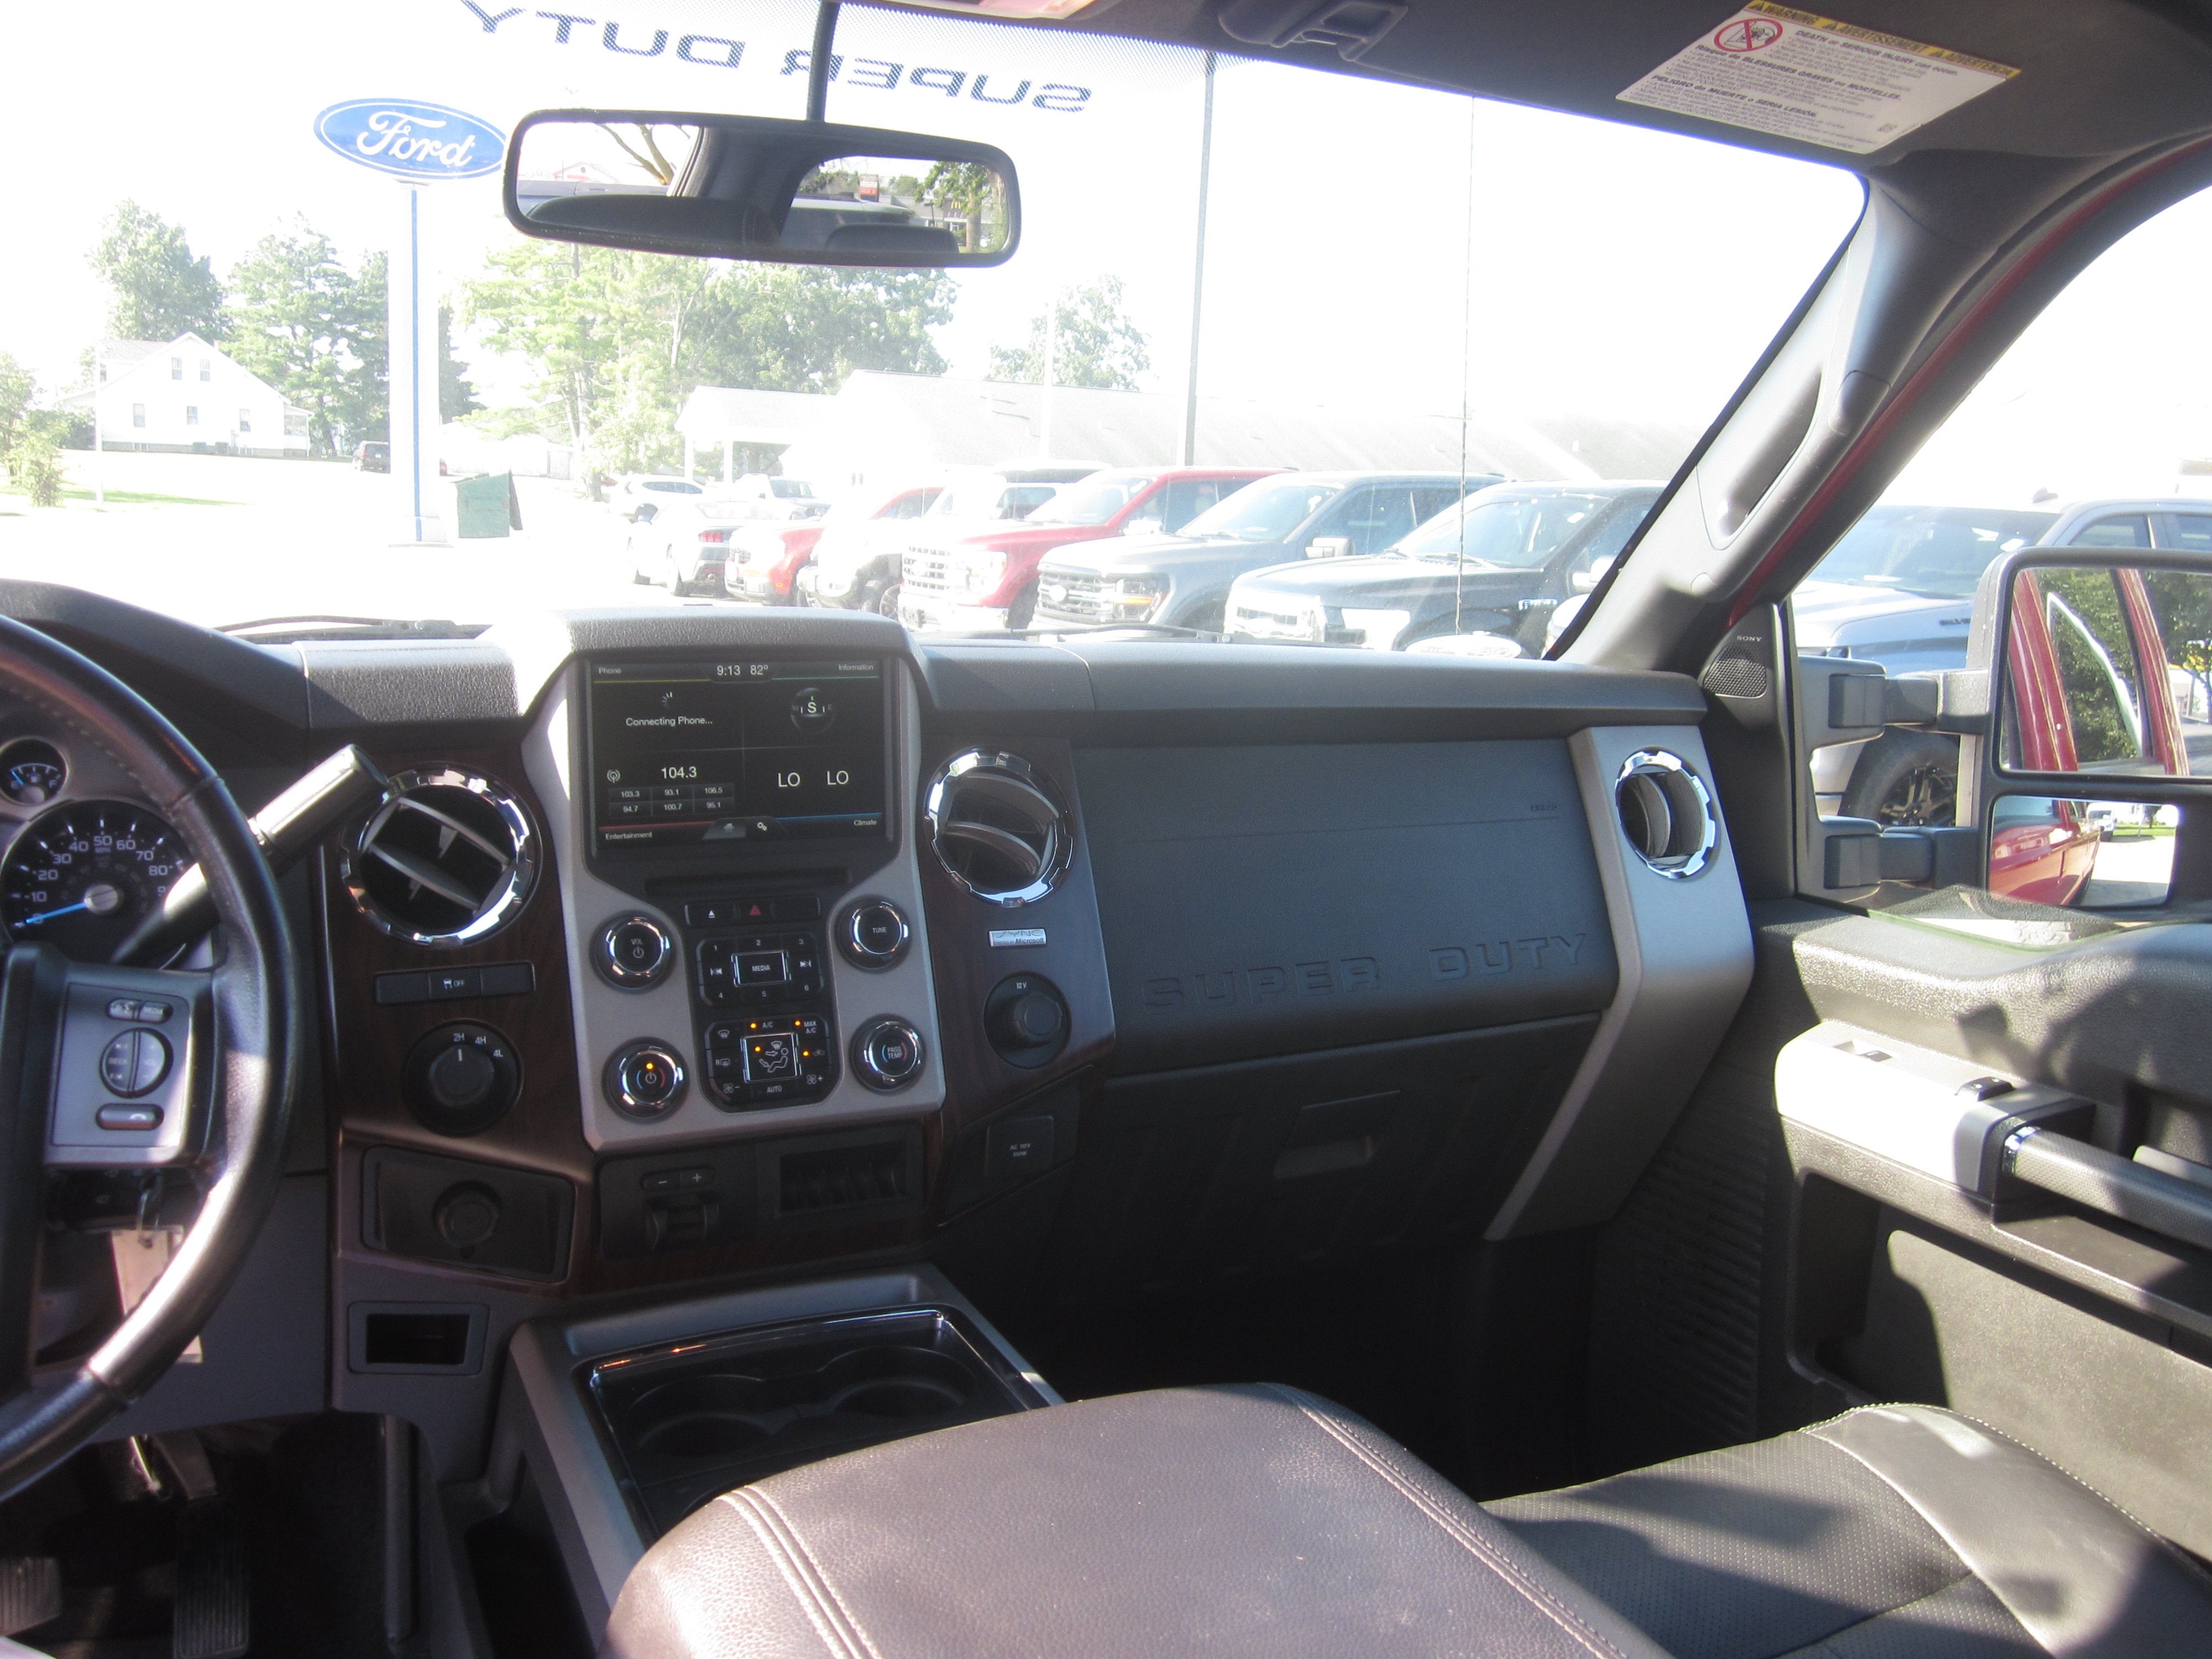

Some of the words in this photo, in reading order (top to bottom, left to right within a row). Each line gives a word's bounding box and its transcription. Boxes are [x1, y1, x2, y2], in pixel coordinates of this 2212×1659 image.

[356, 111, 476, 167] Ford
[717, 665, 741, 676] 9:13
[807, 701, 817, 713] S
[625, 717, 676, 727] Connecting
[661, 766, 697, 779] 104.3
[827, 770, 849, 786] LO
[778, 772, 800, 787] LO
[93, 835, 112, 846] 50
[606, 832, 653, 840] Entertainment
[69, 841, 89, 852] 40
[116, 839, 136, 850] 60
[53, 853, 71, 864] 30
[135, 850, 154, 861] 70
[38, 869, 59, 880] 20
[148, 865, 168, 876] 80
[32, 891, 47, 902] 10
[996, 930, 1042, 938] SYNC
[1143, 956, 1381, 1007] SUPER
[1430, 933, 1587, 982] DUTY
[1016, 982, 1027, 990] 12V
[453, 1033, 465, 1042] 2H
[475, 1036, 487, 1045] 4H
[493, 1049, 504, 1057] 4L
